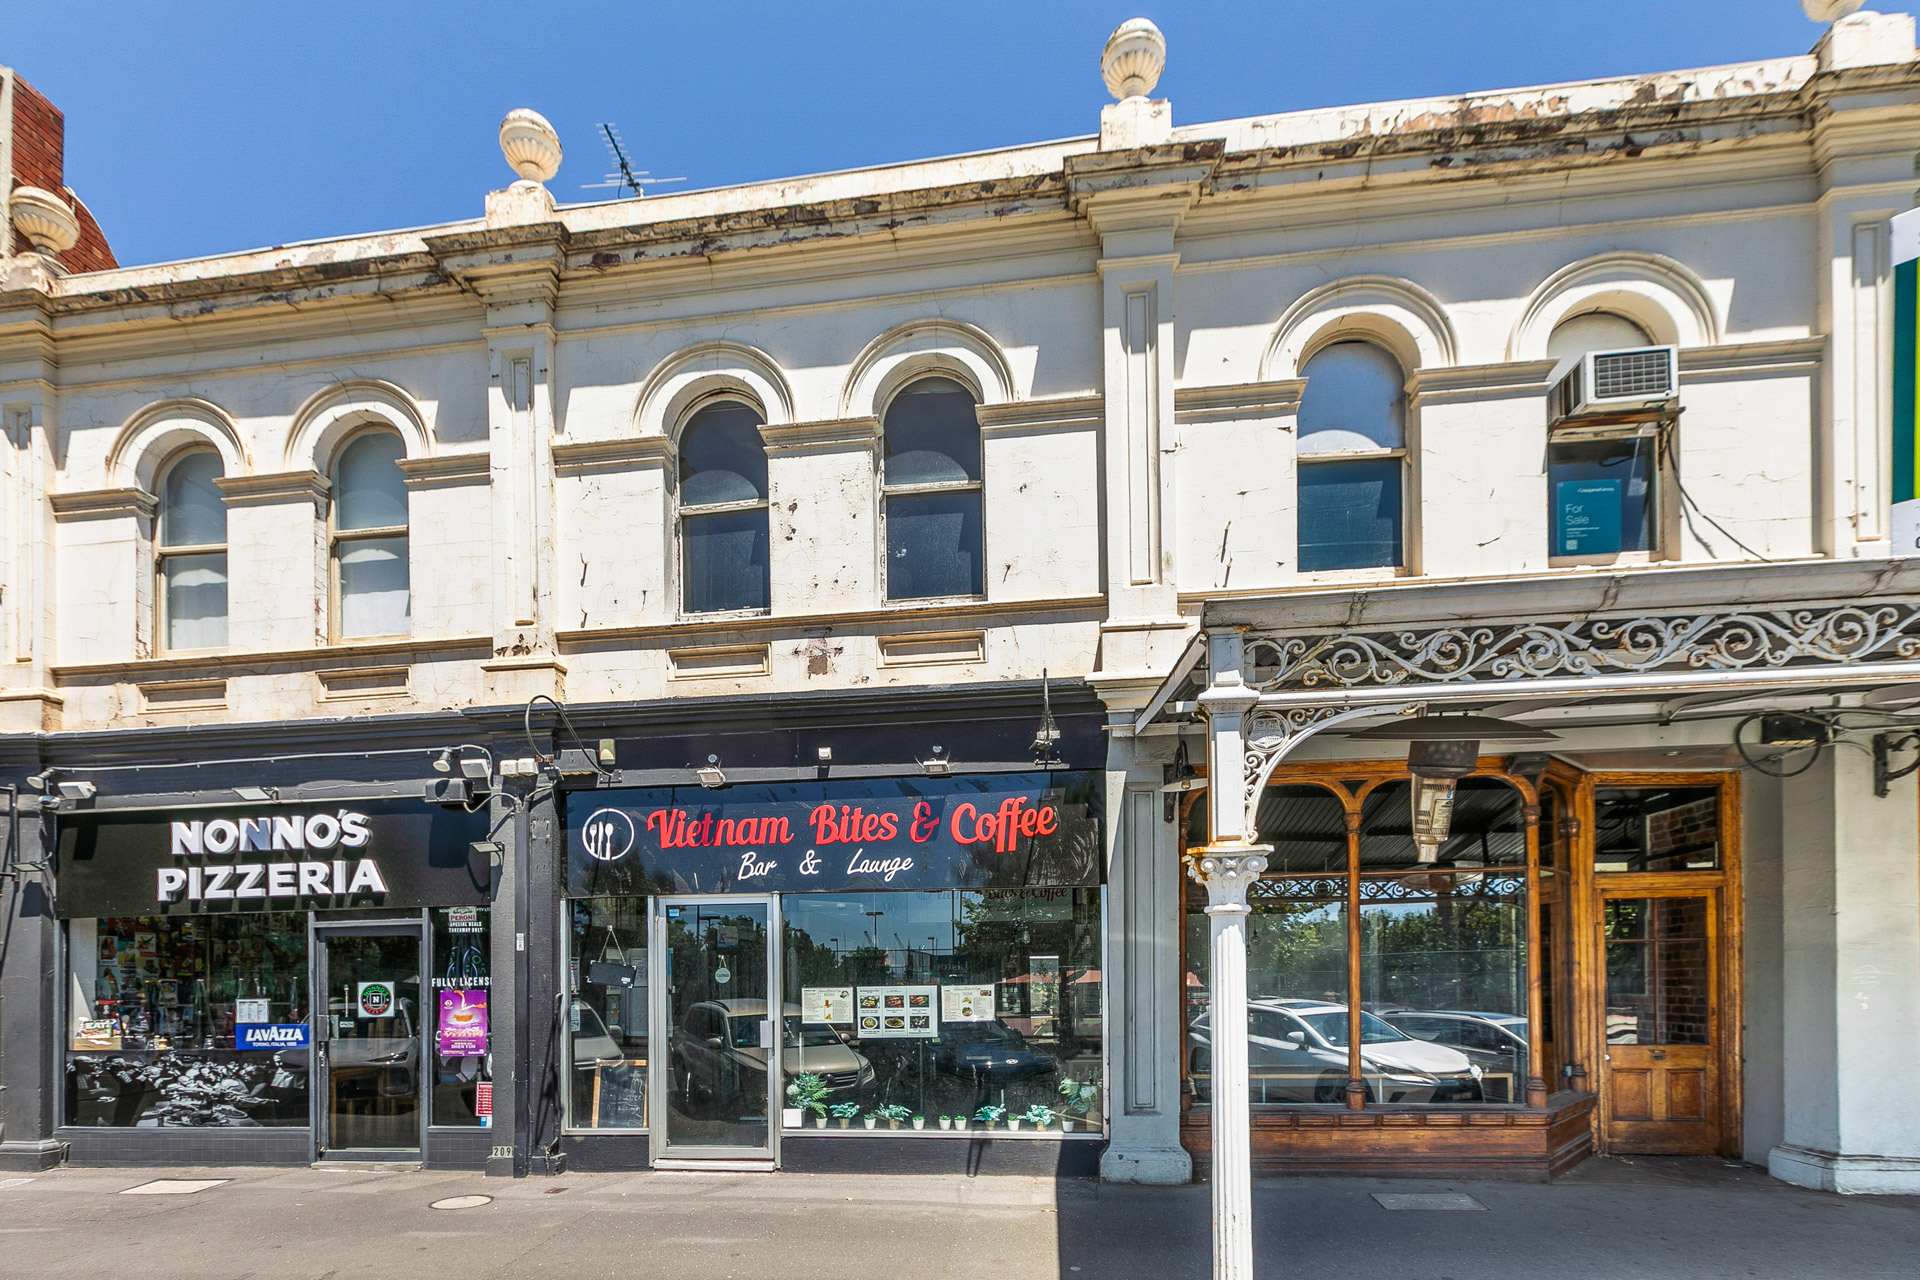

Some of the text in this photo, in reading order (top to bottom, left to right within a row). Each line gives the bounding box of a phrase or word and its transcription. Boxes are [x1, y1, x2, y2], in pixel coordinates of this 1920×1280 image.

[1565, 504, 1583, 514] For
[1566, 515, 1589, 525] Sale
[170, 809, 373, 855] NONNO'S
[647, 796, 1057, 853] Vietnam Bites & Coffee
[737, 851, 777, 880] Bar
[799, 850, 822, 875] &
[156, 859, 388, 901] PIZZERIA
[432, 978, 457, 987] FULLY
[245, 1026, 304, 1041] LAVAZZA
[493, 1147, 511, 1156] 209
